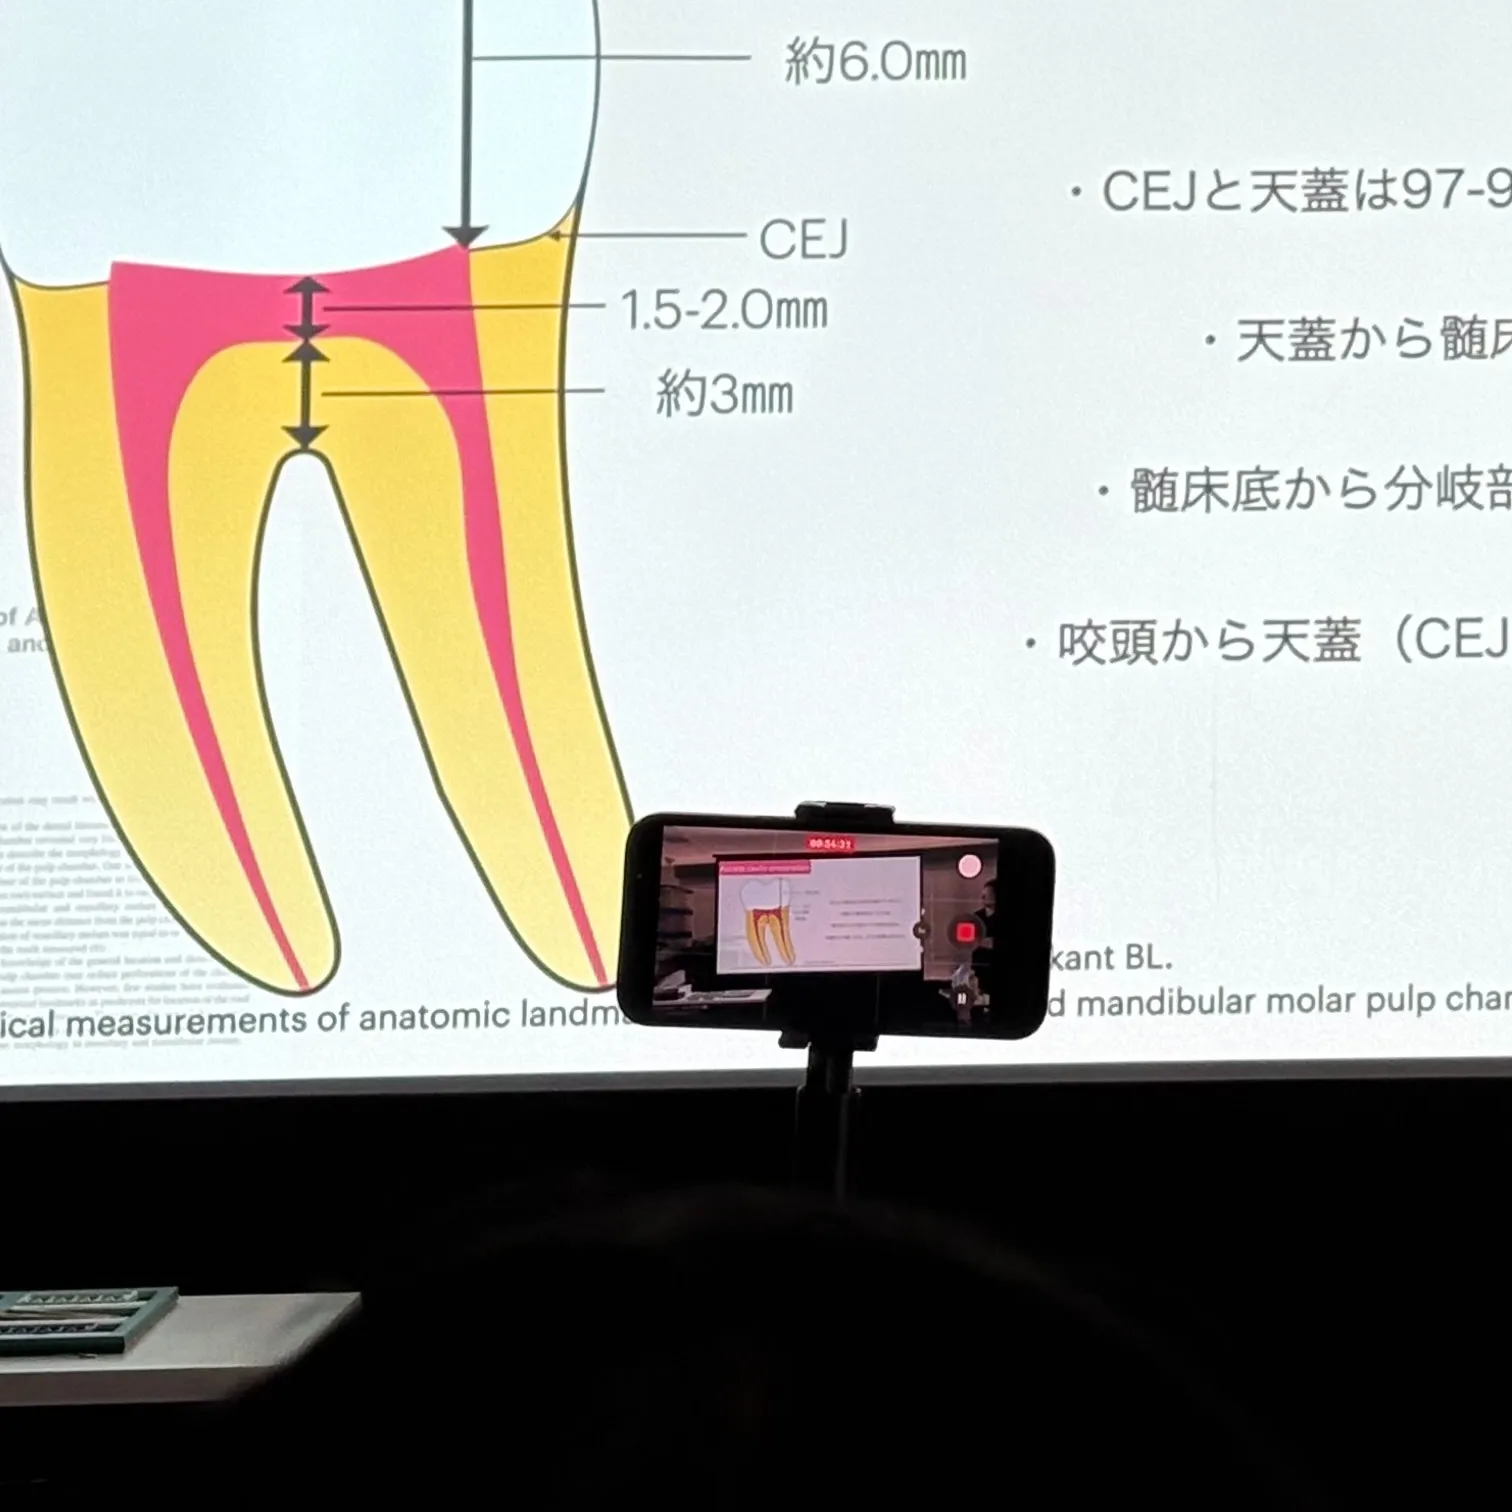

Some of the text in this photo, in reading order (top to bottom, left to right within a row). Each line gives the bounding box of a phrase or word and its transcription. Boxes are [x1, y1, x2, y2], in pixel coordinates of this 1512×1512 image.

[760, 217, 848, 260] CEJ
[621, 288, 828, 330] 1.5-2.0mm
[1126, 943, 1173, 970] BL.
[0, 1008, 55, 1039] ical
[66, 1008, 307, 1038] measurements
[317, 1001, 351, 1033] of
[359, 999, 511, 1032] anatomic
[521, 997, 631, 1028] landm
[1076, 985, 1257, 1017] mandibular
[1267, 984, 1357, 1014] molar
[1366, 983, 1437, 1019] pulp
